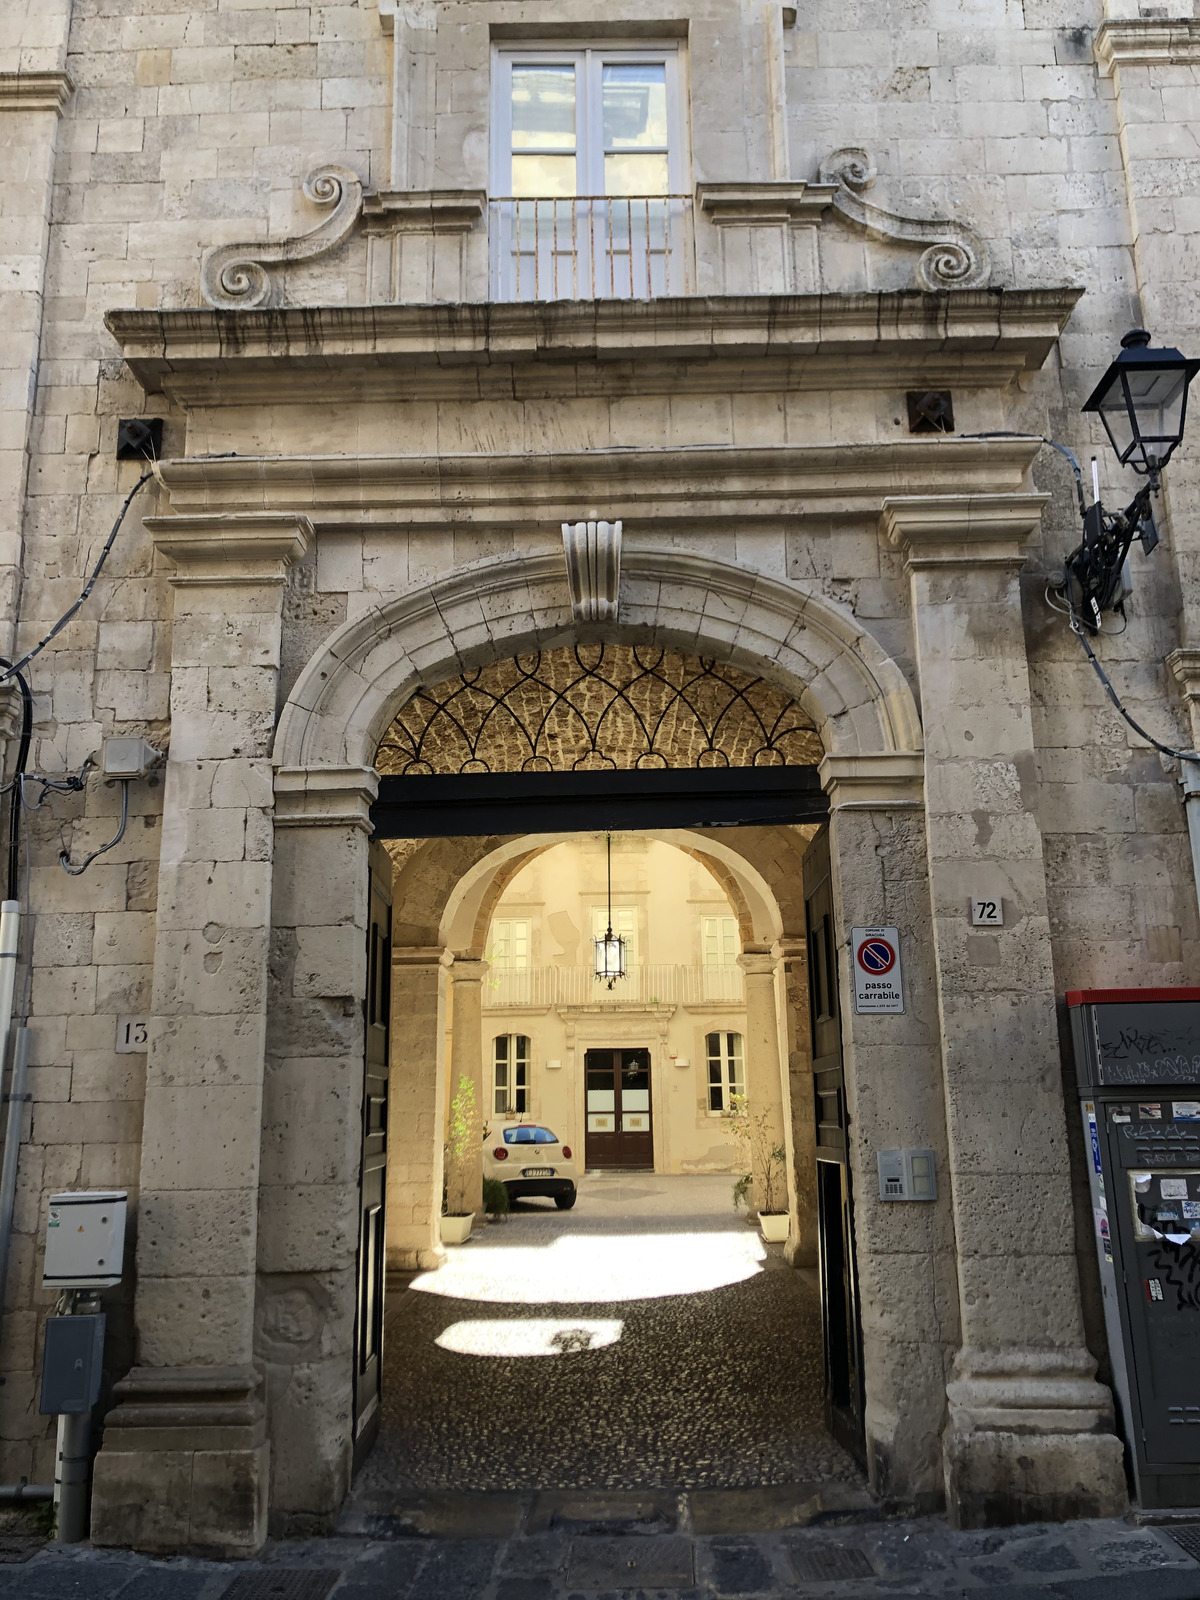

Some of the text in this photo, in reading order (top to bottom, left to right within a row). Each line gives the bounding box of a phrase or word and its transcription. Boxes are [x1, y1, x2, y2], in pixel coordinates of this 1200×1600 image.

[977, 901, 997, 919] 72
[865, 982, 892, 990] passo
[858, 991, 900, 1000] carrabile
[125, 1022, 148, 1044] 13
